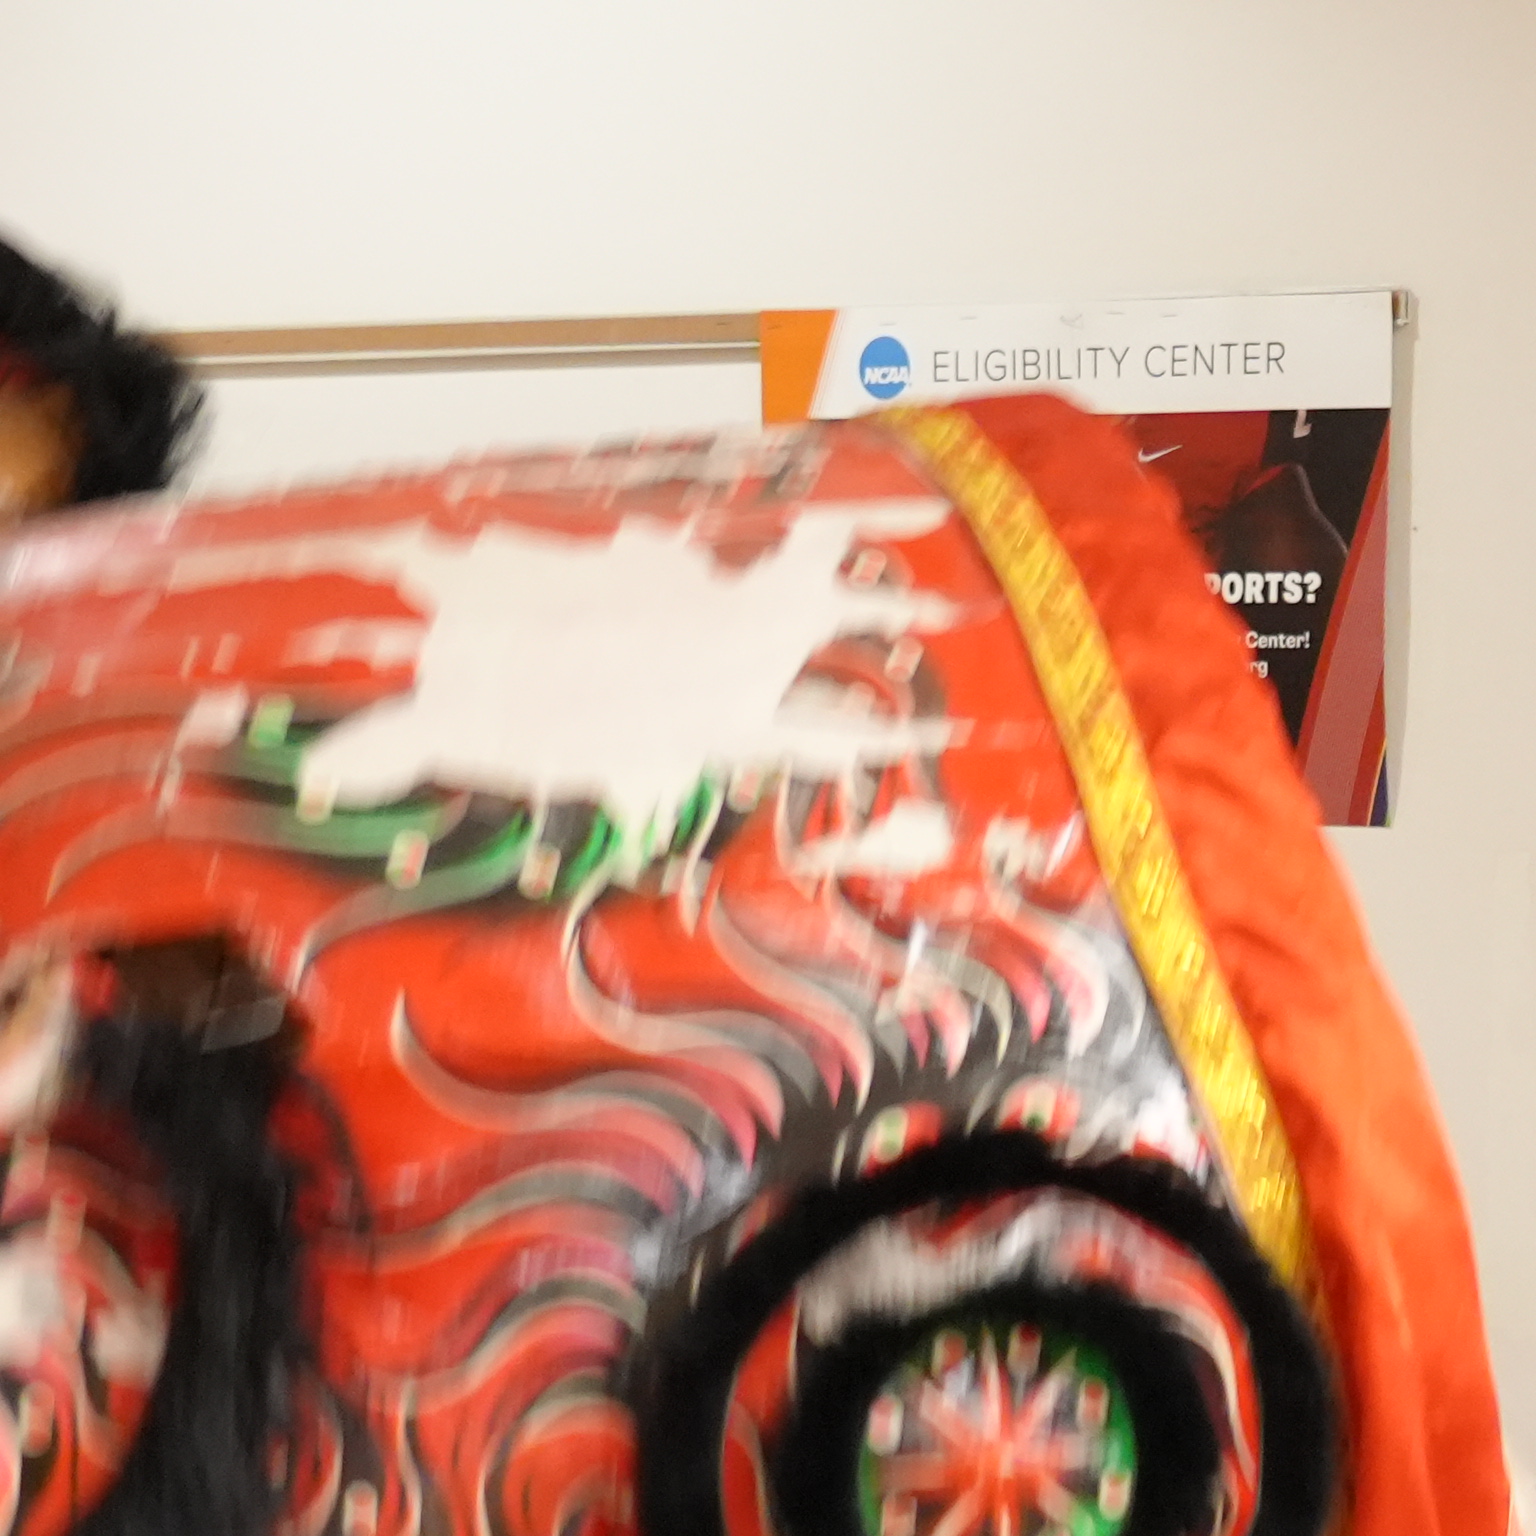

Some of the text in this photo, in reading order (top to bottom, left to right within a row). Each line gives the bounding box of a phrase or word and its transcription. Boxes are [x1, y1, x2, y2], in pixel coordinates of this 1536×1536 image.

[933, 341, 1286, 383] ELIGIBILITY CENTER
[864, 366, 911, 385] NCAA
[1204, 571, 1322, 605] PORTS?
[1245, 630, 1311, 649] Center!
